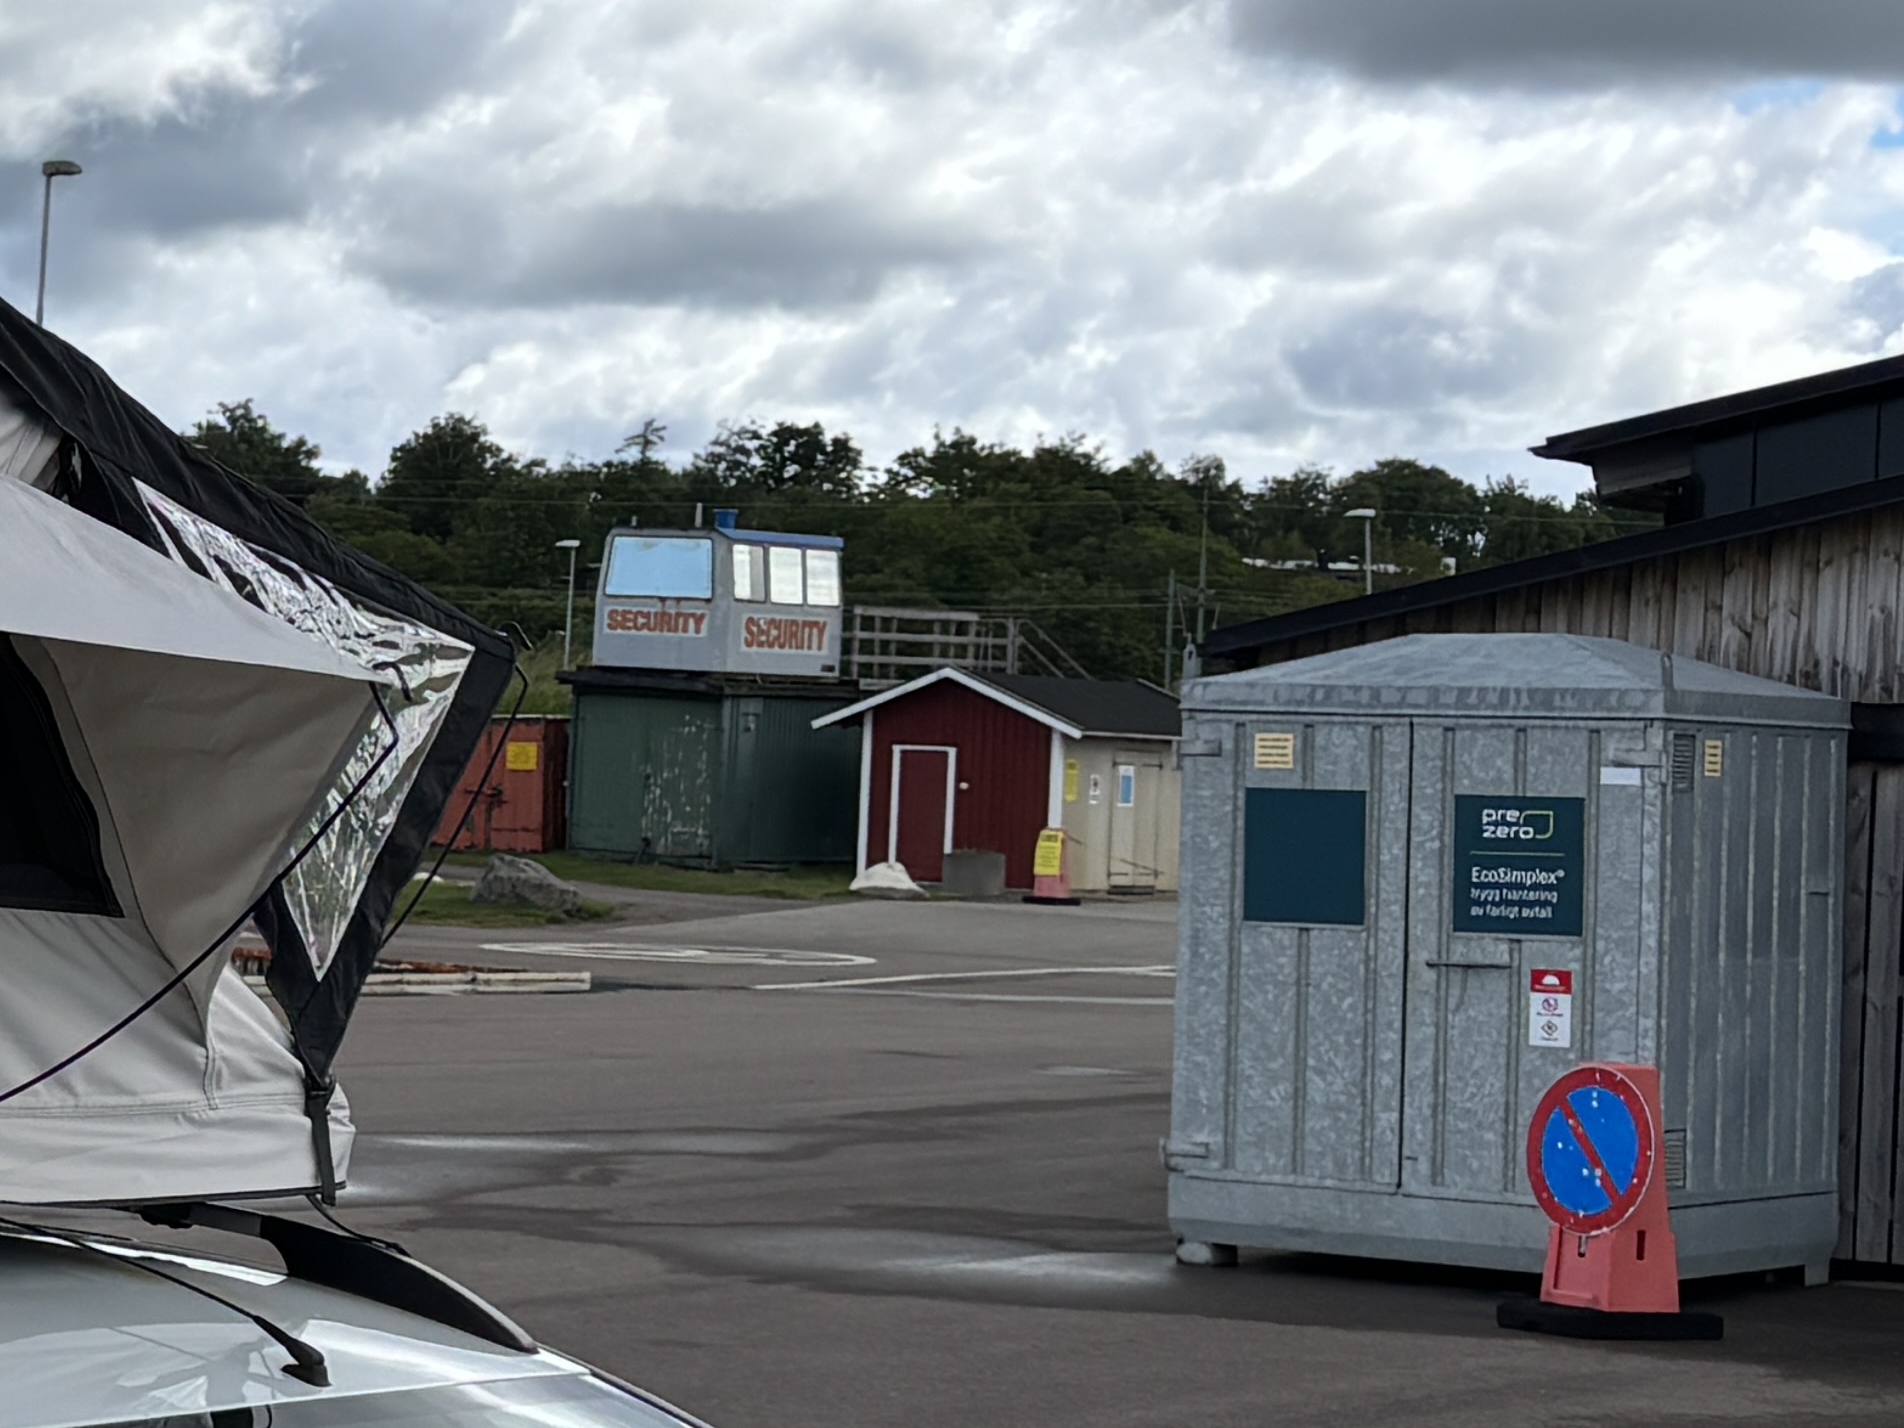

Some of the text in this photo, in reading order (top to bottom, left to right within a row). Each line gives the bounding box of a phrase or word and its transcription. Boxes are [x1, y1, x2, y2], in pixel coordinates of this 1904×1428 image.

[607, 608, 707, 635] SECURITY
[744, 616, 828, 652] SECURITY
[1482, 809, 1520, 824] pre
[1482, 825, 1534, 839] zero
